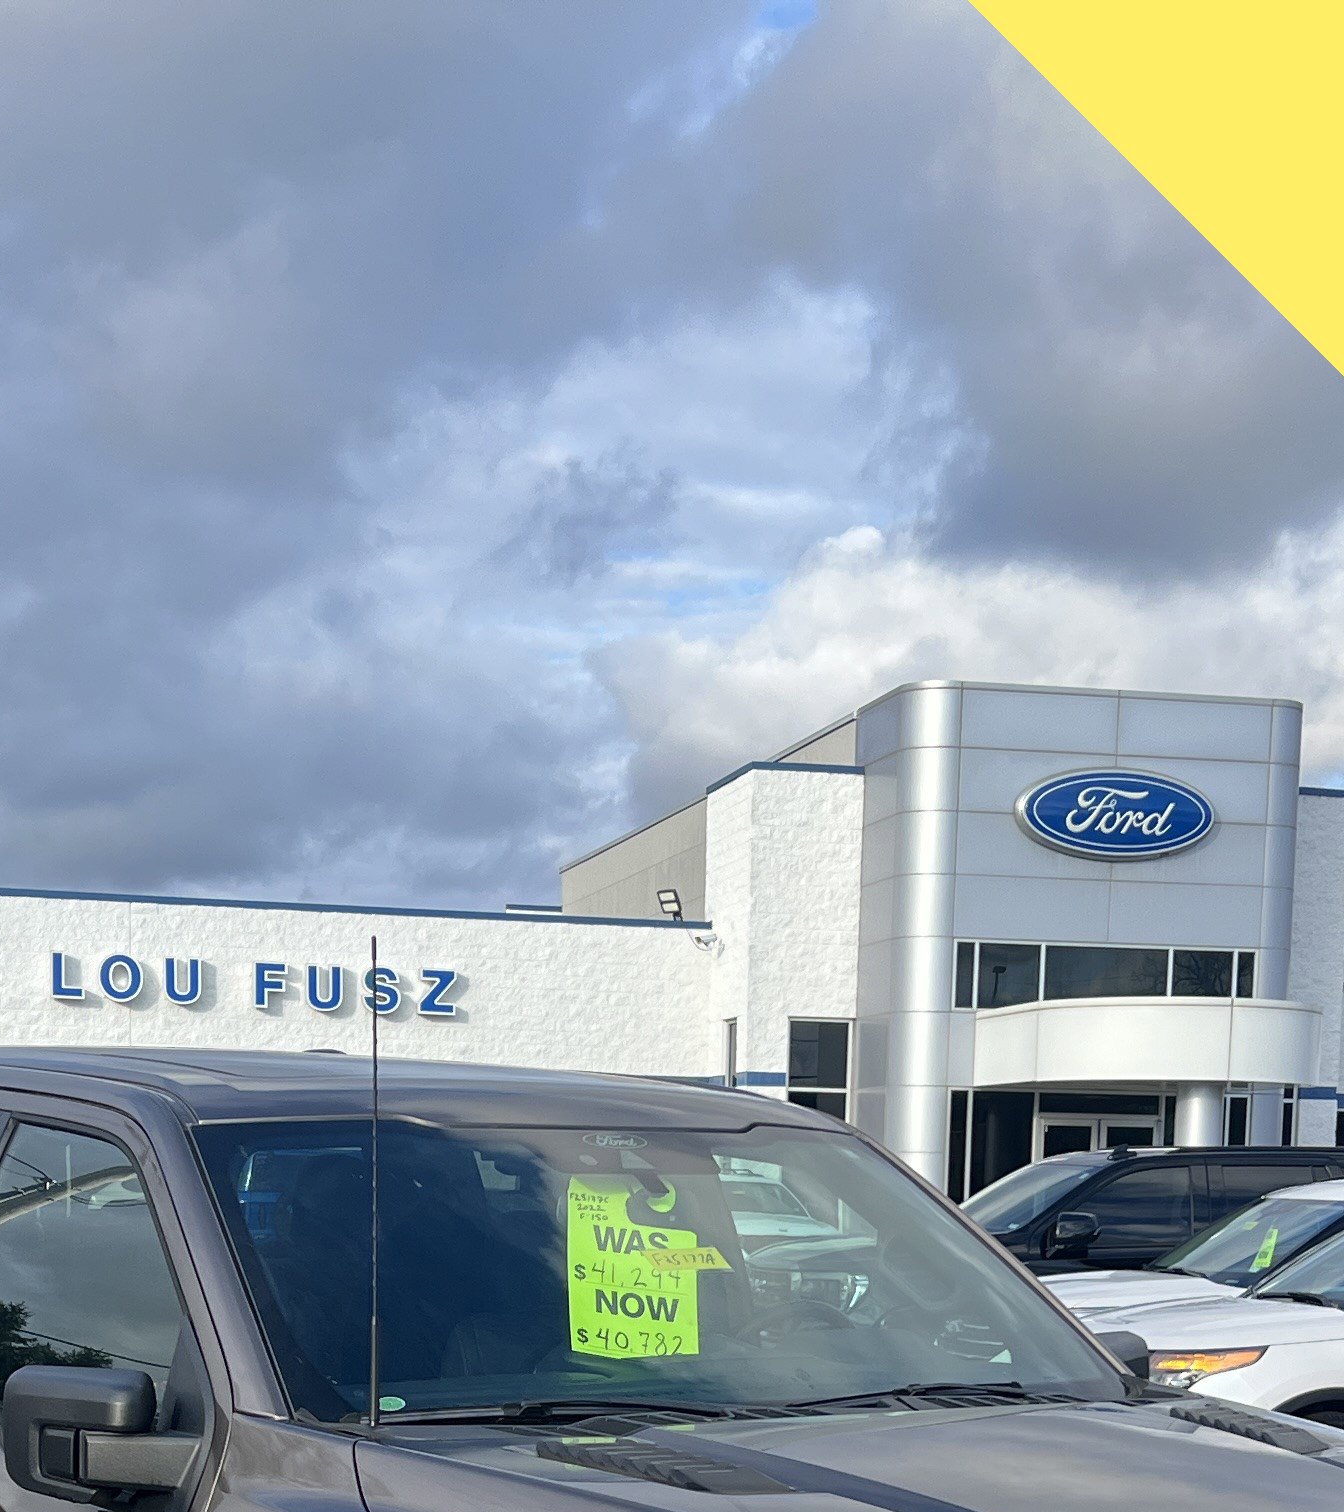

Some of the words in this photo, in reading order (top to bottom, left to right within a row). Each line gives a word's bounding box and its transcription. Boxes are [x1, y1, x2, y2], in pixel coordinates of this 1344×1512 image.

[1065, 786, 1175, 836] Ford
[52, 953, 201, 1003] LOU
[254, 963, 457, 1015] FUSZ
[596, 1134, 638, 1147] Ford
[576, 1203, 607, 1211] 2022
[593, 1224, 669, 1256] WAS
[595, 1288, 680, 1323] NOW
